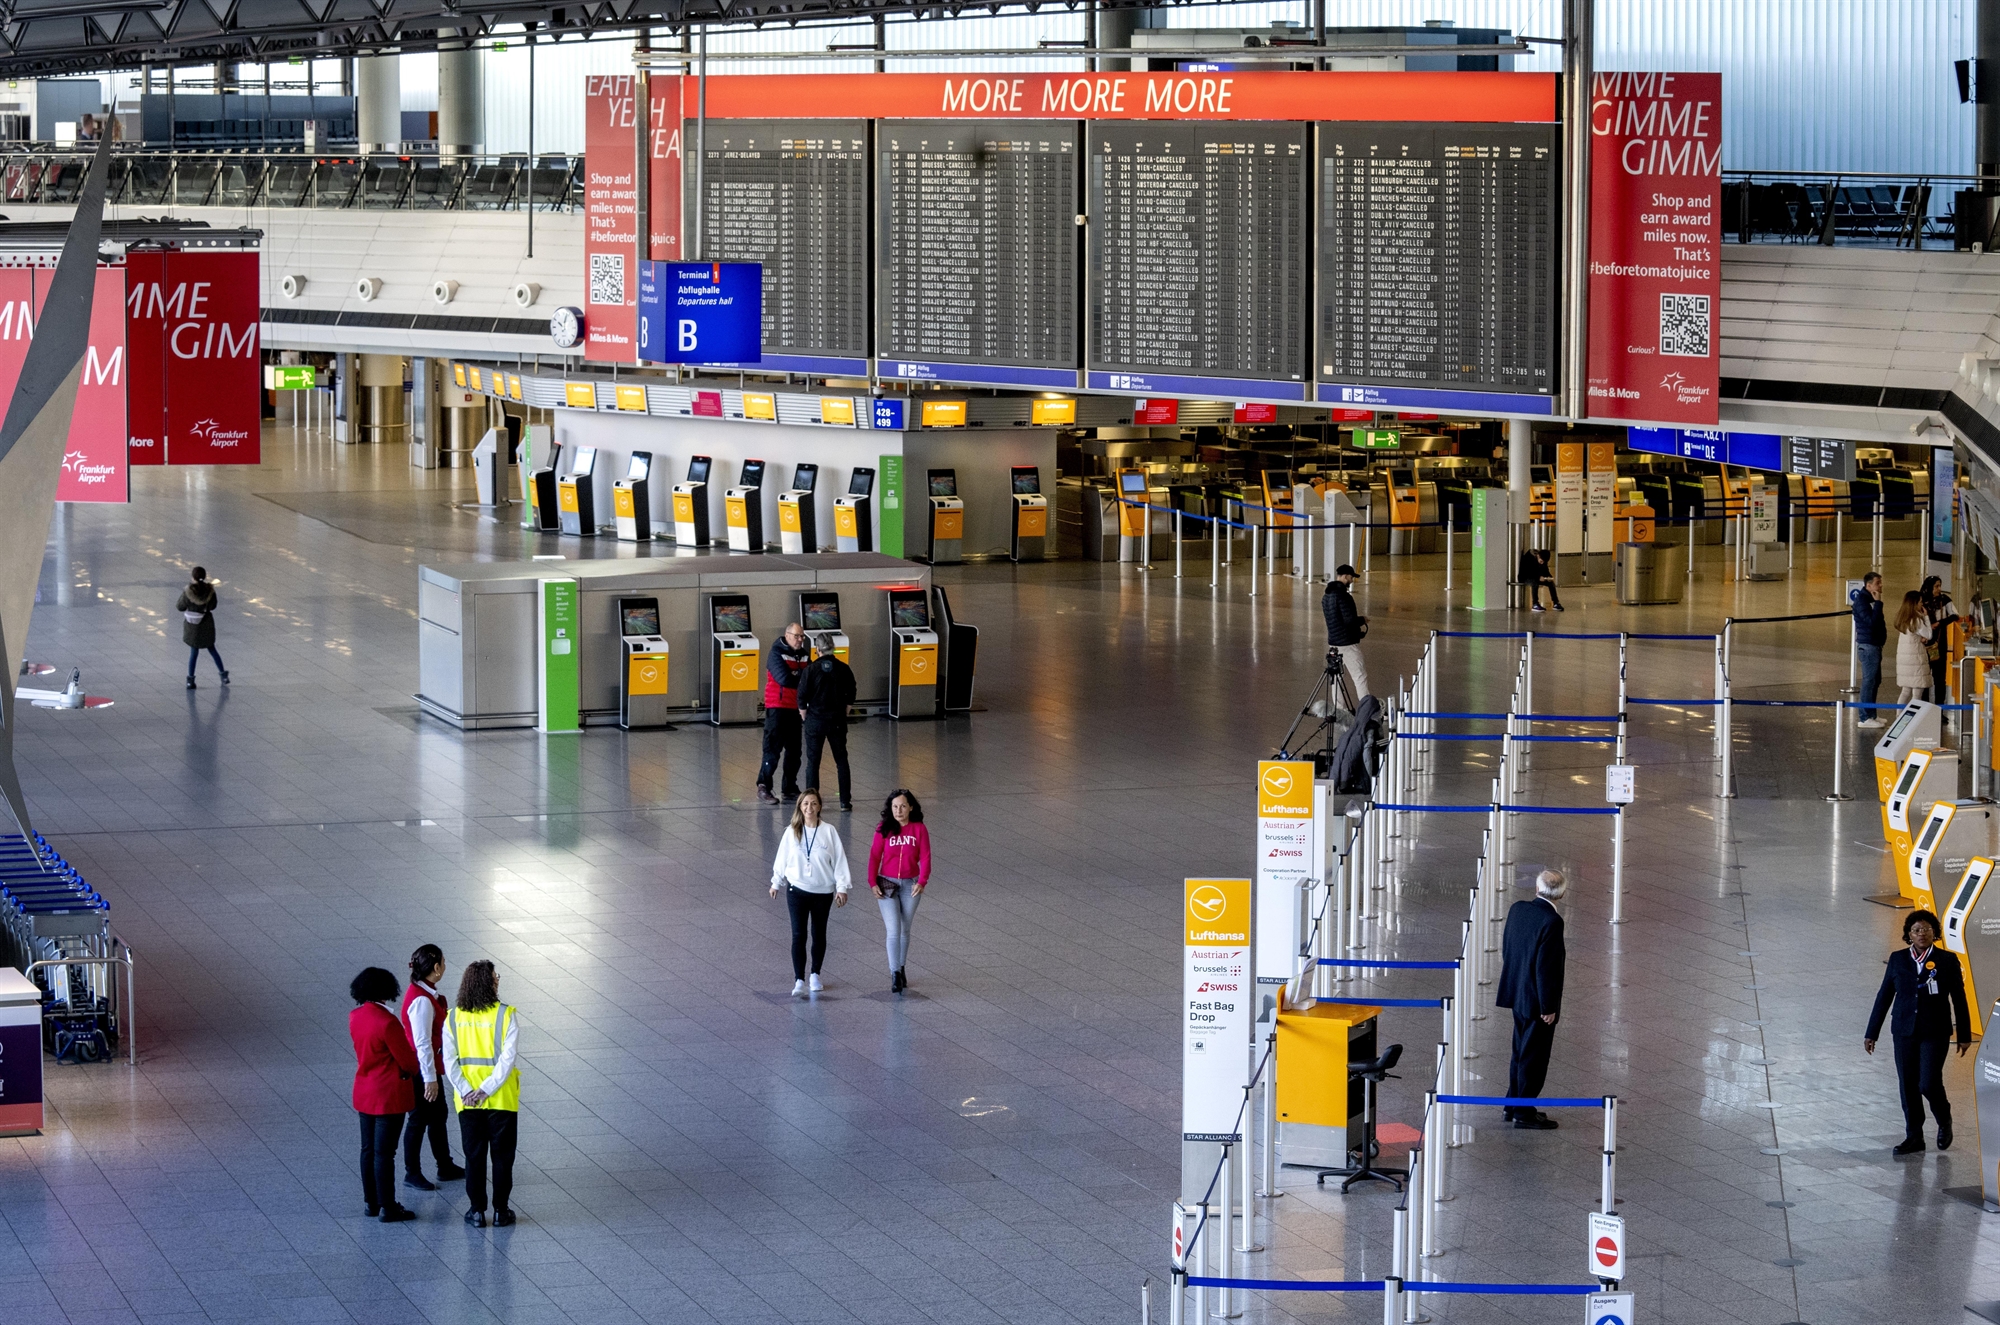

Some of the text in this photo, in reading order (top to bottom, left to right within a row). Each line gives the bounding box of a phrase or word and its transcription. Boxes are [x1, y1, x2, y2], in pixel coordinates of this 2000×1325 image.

[942, 79, 1233, 112] MORE MORE MORE
[1593, 100, 1711, 137] GIMME
[591, 174, 631, 187] Shop and
[591, 190, 610, 199] earn
[1652, 193, 1711, 211] Shop and
[591, 203, 635, 213] miles now.
[1640, 212, 1711, 226] earn award
[1643, 229, 1711, 244] miles now.
[1673, 247, 1711, 261] That’s
[678, 271, 709, 280] Terminal
[1590, 262, 1711, 283] #beforetomatojuice
[678, 286, 720, 296] Abflughalle
[678, 297, 733, 306] Departures hall
[641, 316, 648, 348] B
[678, 319, 698, 352] B
[590, 334, 628, 343] Miles & More
[1628, 346, 1655, 355] Curious?
[1131, 376, 1144, 384] Abflug
[1365, 389, 1379, 397] Abflug
[1609, 388, 1615, 398] &
[1617, 388, 1640, 399] More
[1678, 386, 1709, 396] Frankfurt
[1677, 395, 1701, 405] Airport
[876, 408, 895, 416] 428-
[877, 419, 892, 427] 499
[211, 431, 248, 440] Frankfurt
[210, 439, 238, 448] Airport
[79, 465, 115, 474] Frankfurt
[78, 474, 106, 484] Airport
[1263, 805, 1309, 814] Lufthansa
[889, 835, 917, 847] GANT
[1190, 930, 1245, 941] Lufthansa
[1191, 951, 1229, 959] Austrian
[1194, 965, 1228, 973] brussels
[1210, 984, 1238, 992] SWISS
[1190, 1001, 1235, 1013] Fast Bag
[1190, 1012, 1215, 1023] Drop
[1604, 1221, 1619, 1229] Eingang
